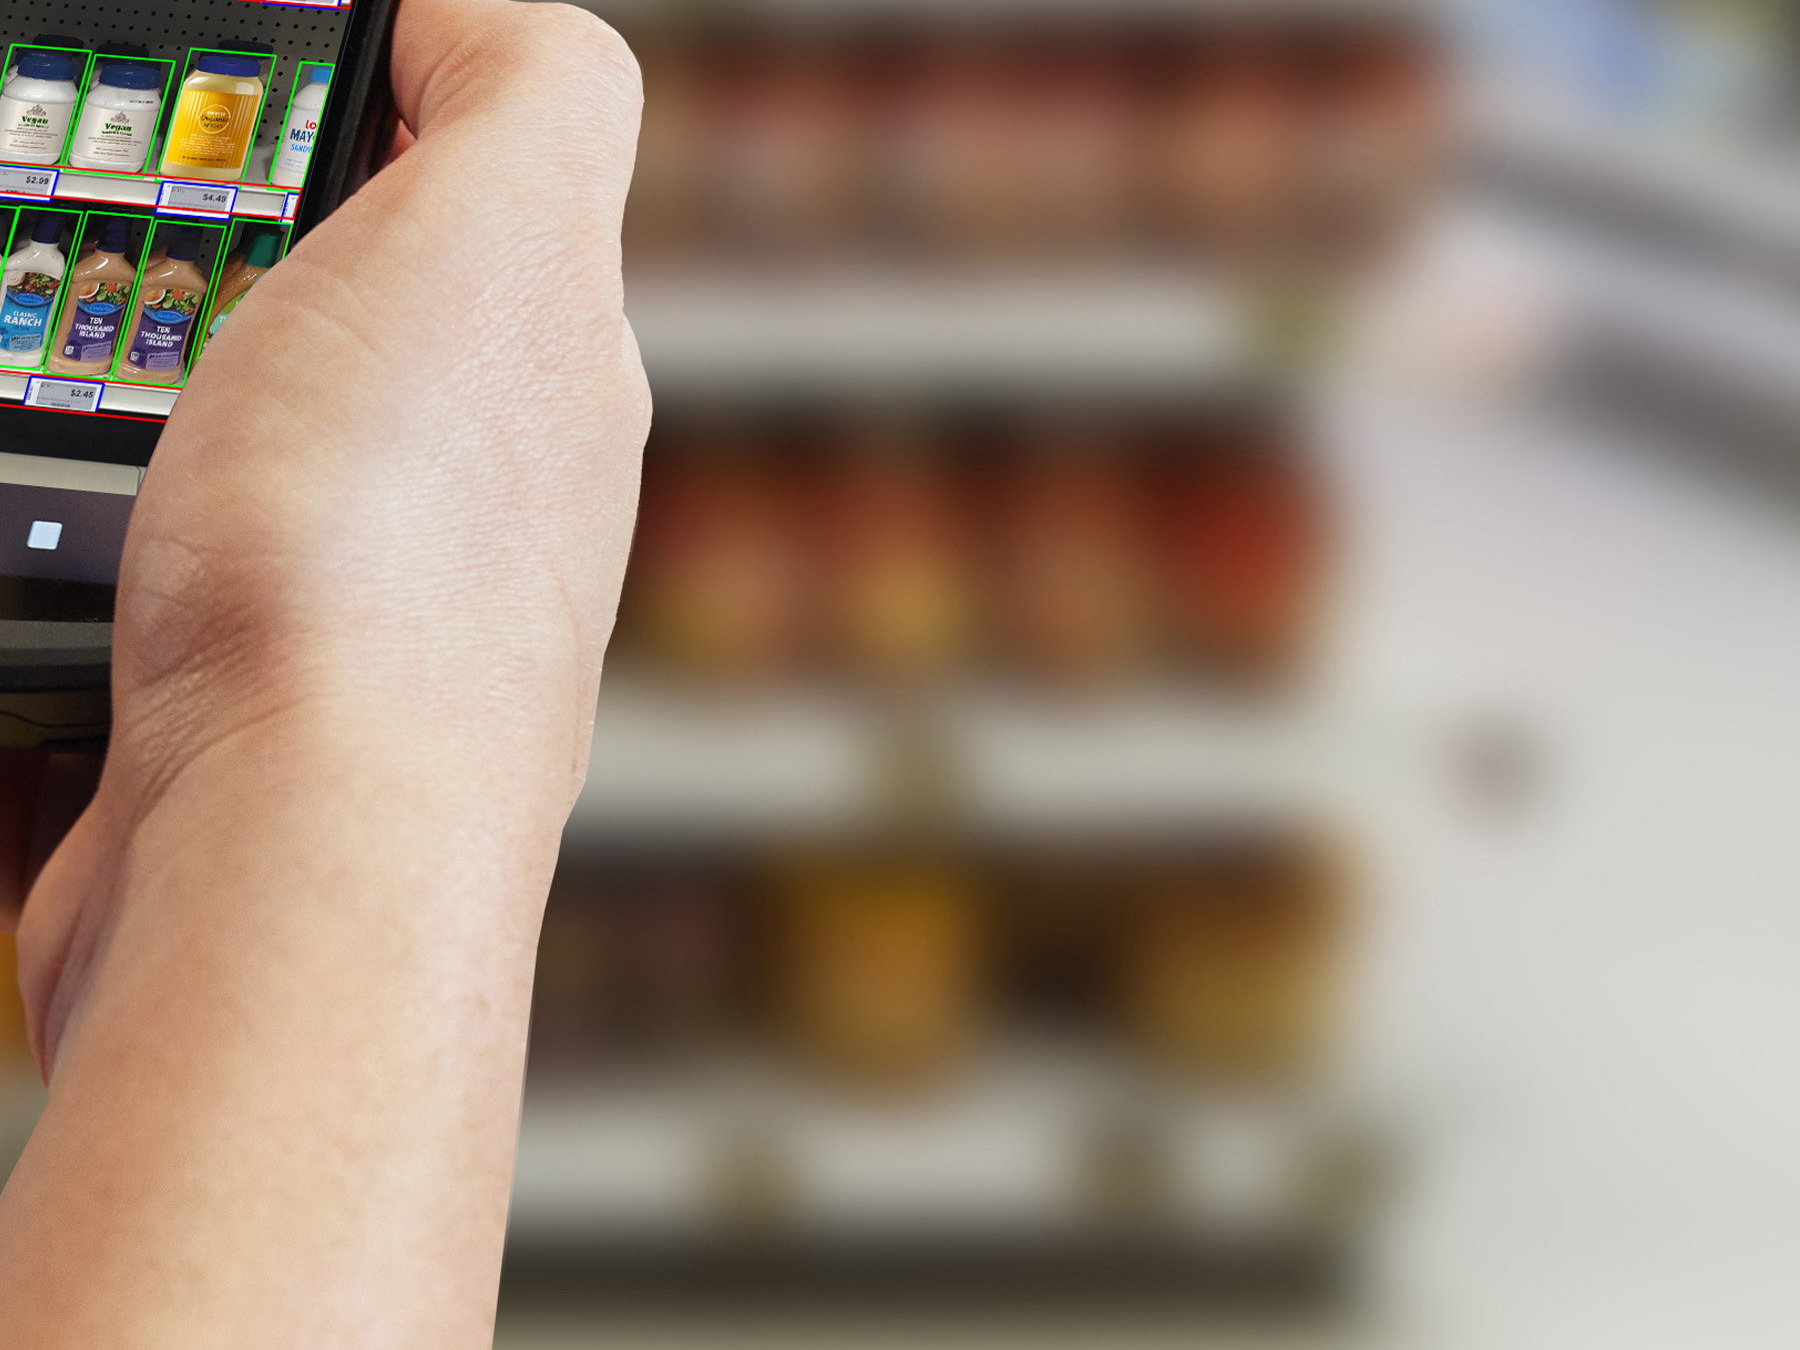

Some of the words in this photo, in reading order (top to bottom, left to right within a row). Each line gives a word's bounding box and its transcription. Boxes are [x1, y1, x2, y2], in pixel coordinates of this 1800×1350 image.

[22, 115, 49, 125] Vegan
[105, 123, 132, 132] Vegan
[290, 128, 315, 143] MAY
[13, 310, 37, 318] CLASSIC
[4, 315, 42, 327] RANCH
[75, 323, 114, 332] THOUSAND
[156, 325, 171, 333] TEN
[79, 330, 106, 338] ISLAND
[141, 331, 182, 341] THOUSAND
[145, 339, 174, 348] ISLAND
[70, 389, 94, 399] $2.45
